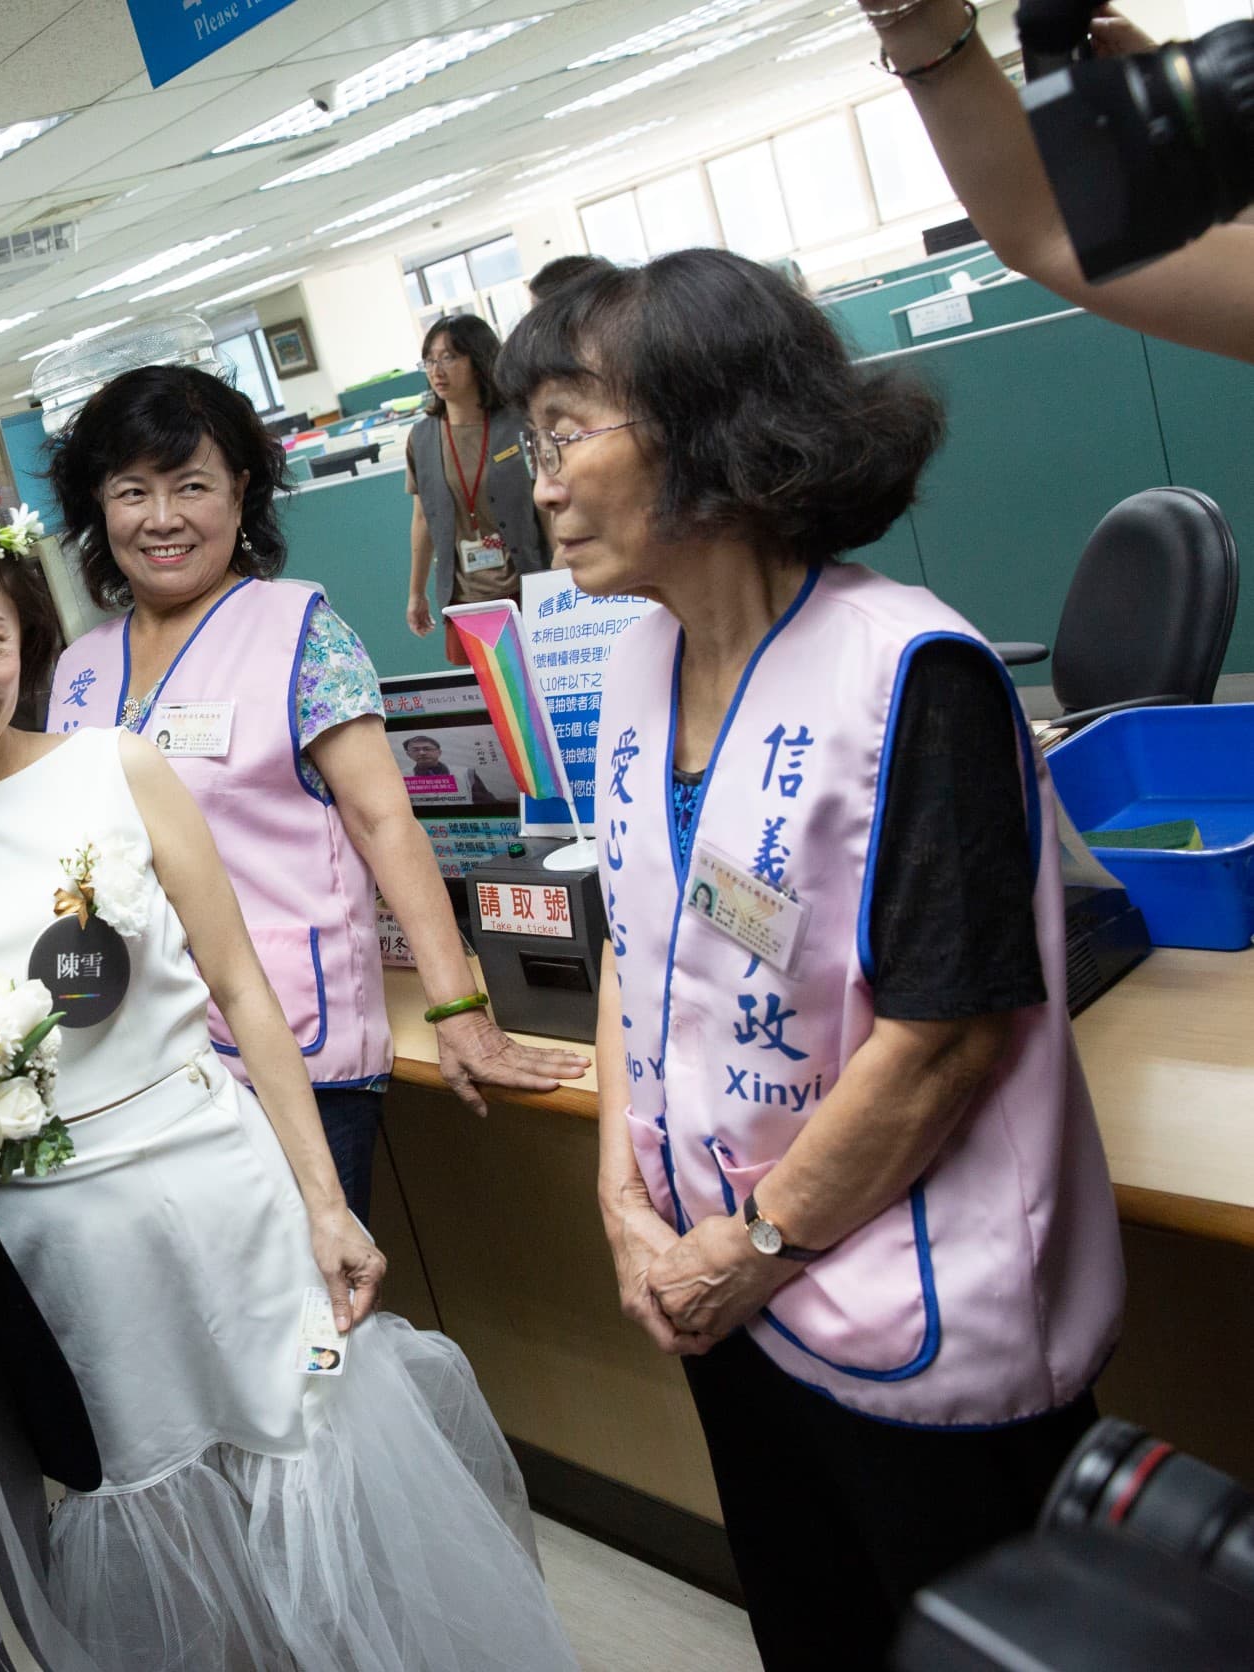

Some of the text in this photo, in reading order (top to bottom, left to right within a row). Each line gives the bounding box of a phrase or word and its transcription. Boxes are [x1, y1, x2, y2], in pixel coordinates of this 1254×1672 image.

[194, 3, 240, 40] Please
[532, 615, 641, 644] 本所自103年04月22
[534, 645, 611, 669] 號櫃檯得受理
[569, 780, 596, 797] 您的
[478, 885, 569, 922] 請取號
[733, 723, 815, 1061] 信義政
[490, 920, 561, 935] Take a ticket
[57, 952, 104, 979] 陳雪
[725, 1064, 822, 1112] Xinyi
